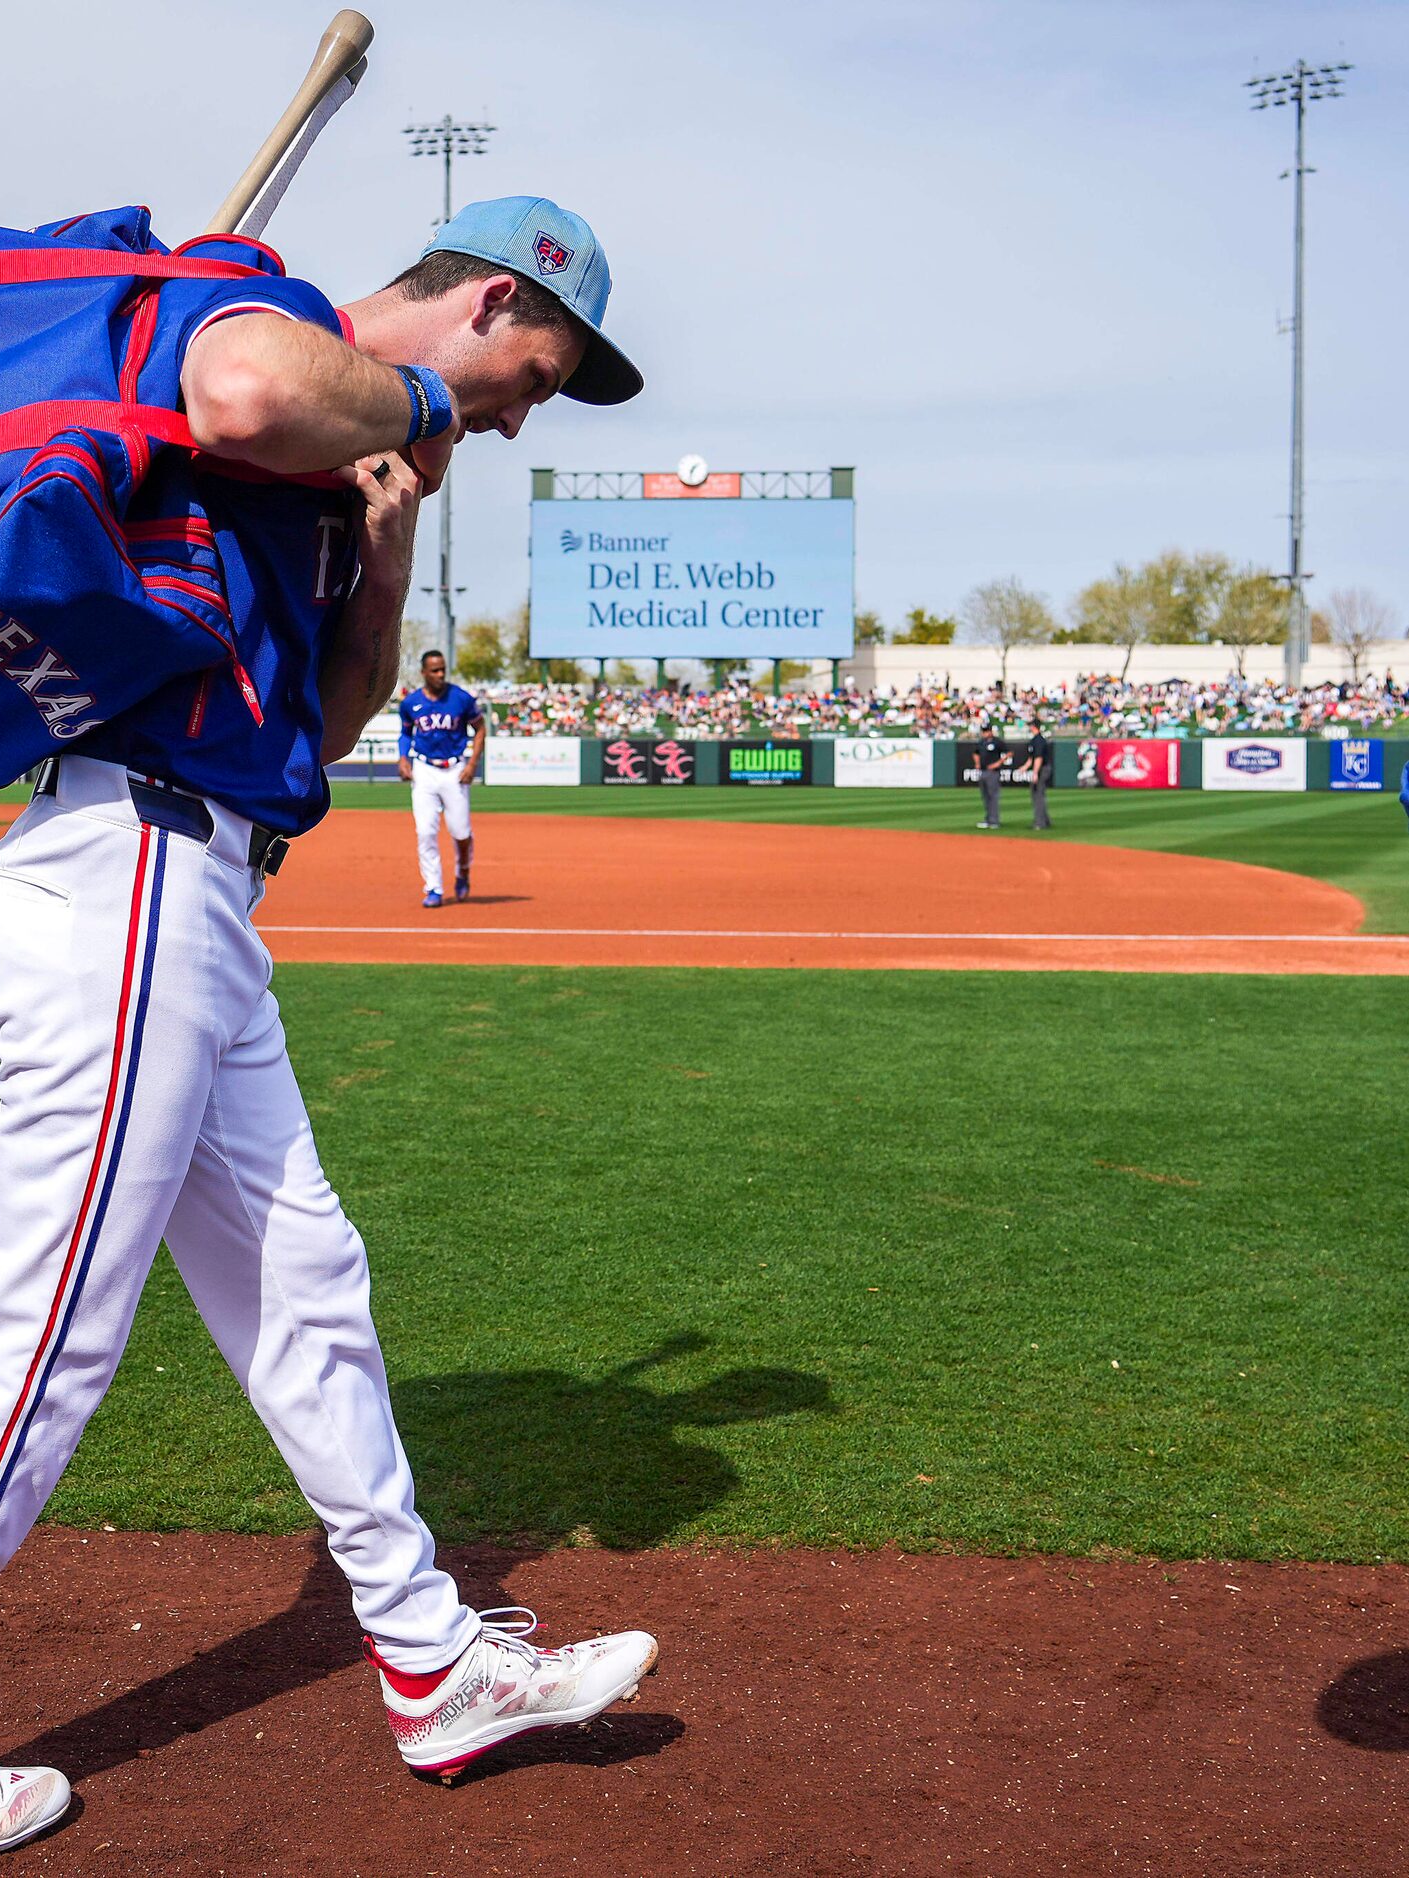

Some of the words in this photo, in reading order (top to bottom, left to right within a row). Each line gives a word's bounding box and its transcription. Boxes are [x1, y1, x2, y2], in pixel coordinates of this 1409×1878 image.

[413, 380, 430, 421] SEGUNDO
[588, 531, 669, 553] Banner
[589, 561, 640, 590] Del
[653, 562, 680, 590] E.
[685, 560, 775, 590] Webb
[588, 599, 708, 628] Medical
[720, 600, 824, 629] Center
